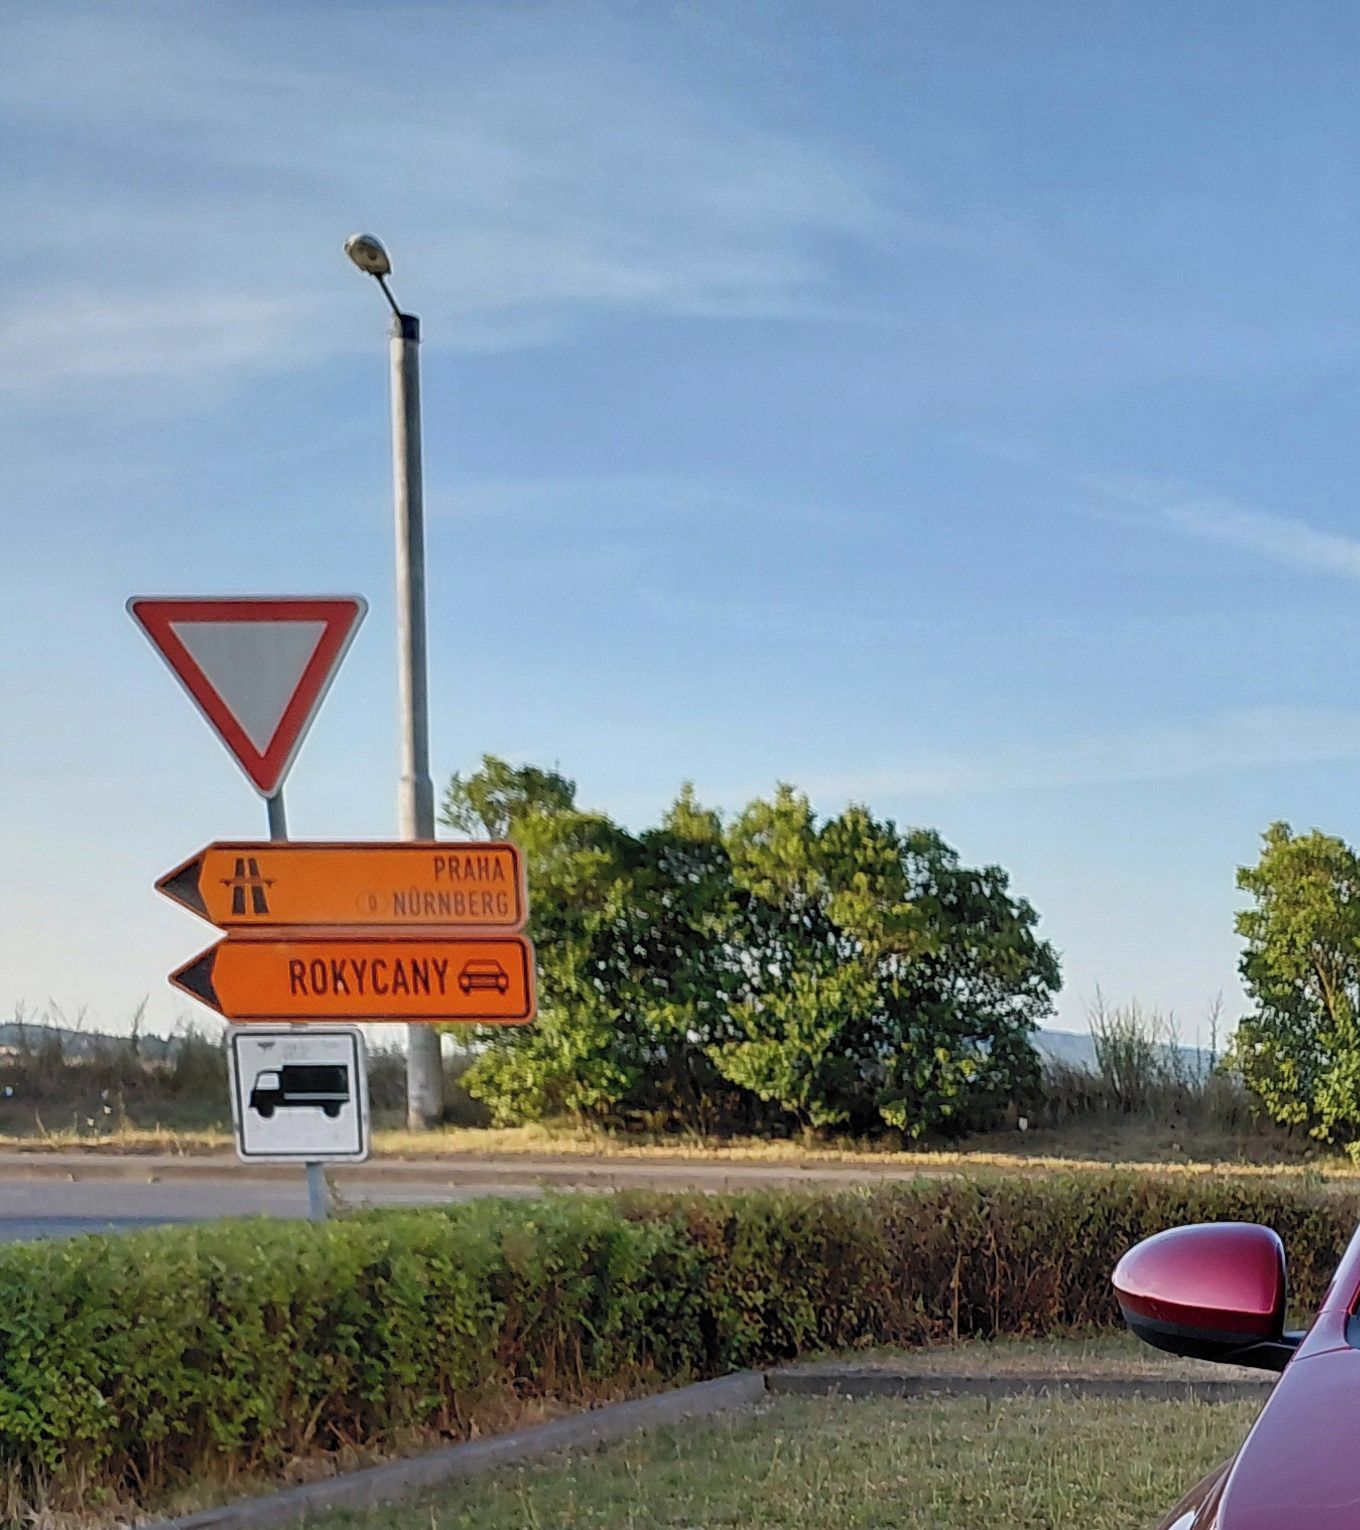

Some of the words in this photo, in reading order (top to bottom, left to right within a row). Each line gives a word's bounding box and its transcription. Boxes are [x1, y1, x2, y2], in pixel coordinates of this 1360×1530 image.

[433, 854, 505, 882] PRAHA
[393, 888, 508, 917] NÜRNBERG
[289, 957, 449, 996] ROKYCANY
